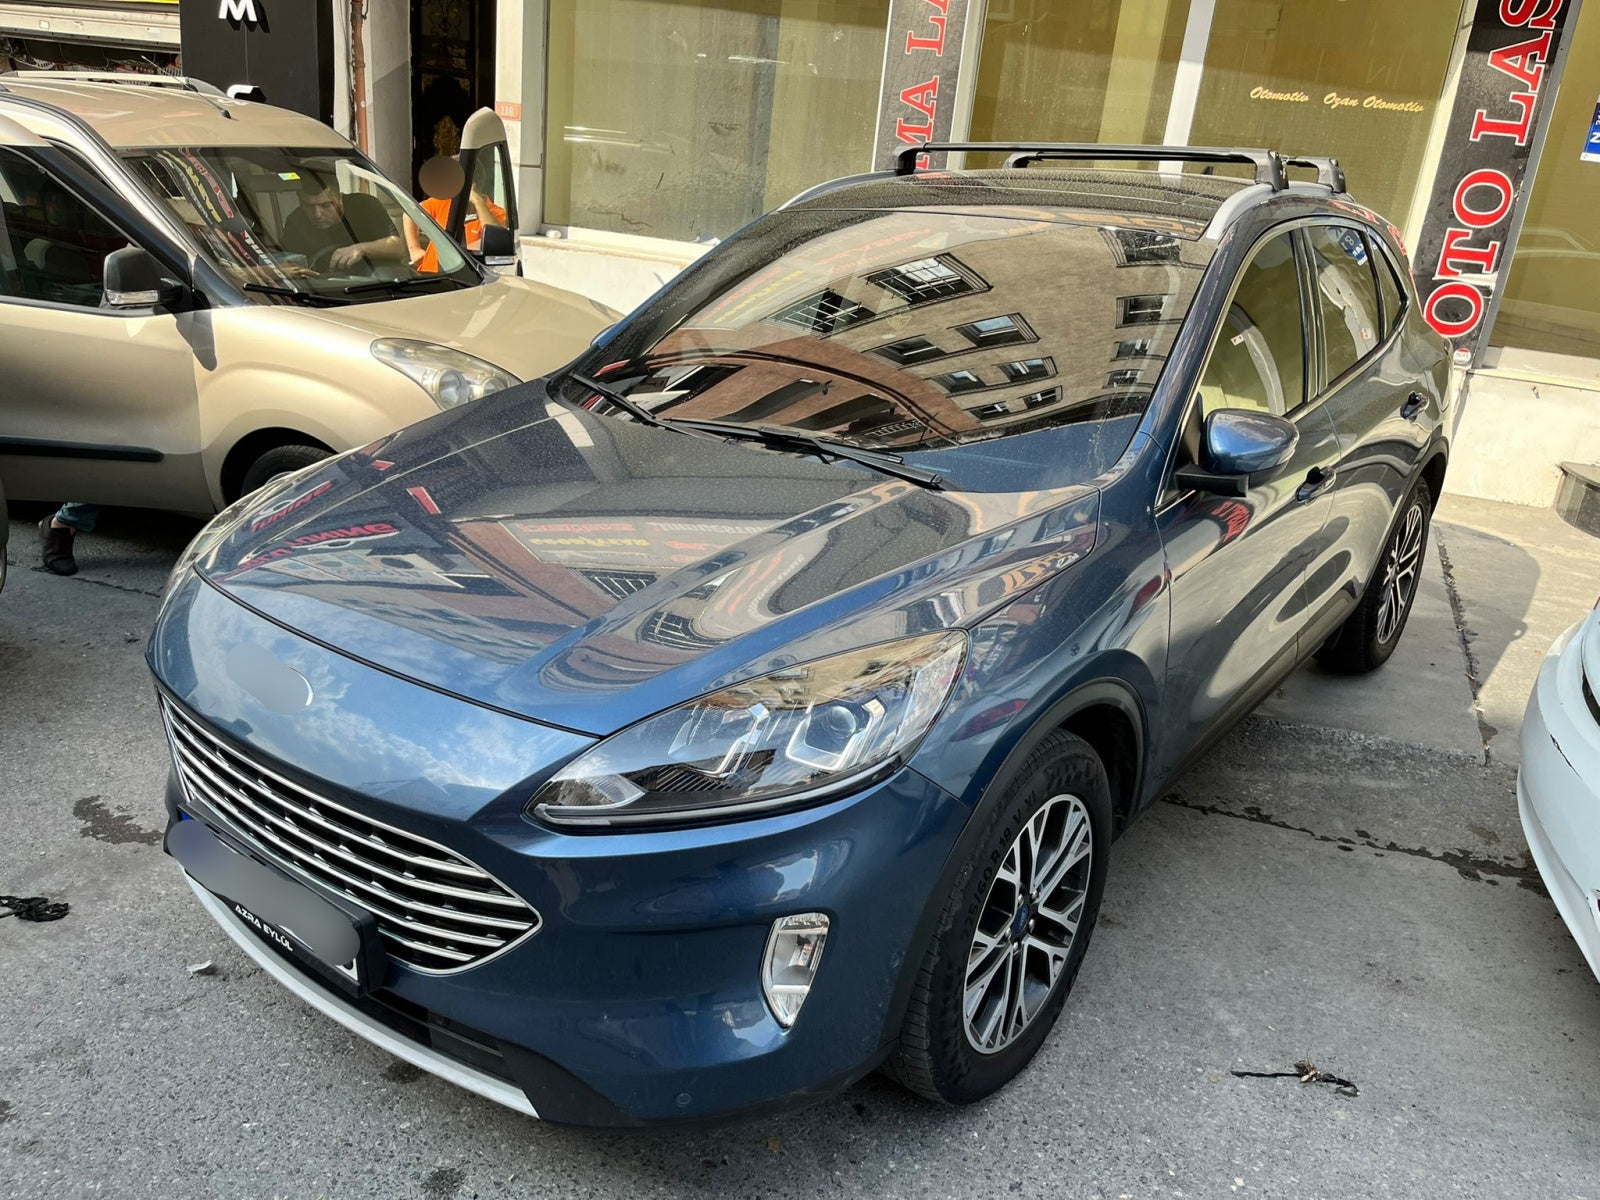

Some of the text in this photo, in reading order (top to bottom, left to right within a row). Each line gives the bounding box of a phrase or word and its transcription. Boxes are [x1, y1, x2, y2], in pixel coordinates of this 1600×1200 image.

[904, 0, 950, 57] L
[1250, 86, 1425, 112] Otomotiv Ozan Otomotiv
[1423, 168, 1514, 338] OTO
[235, 904, 262, 929] AZRA
